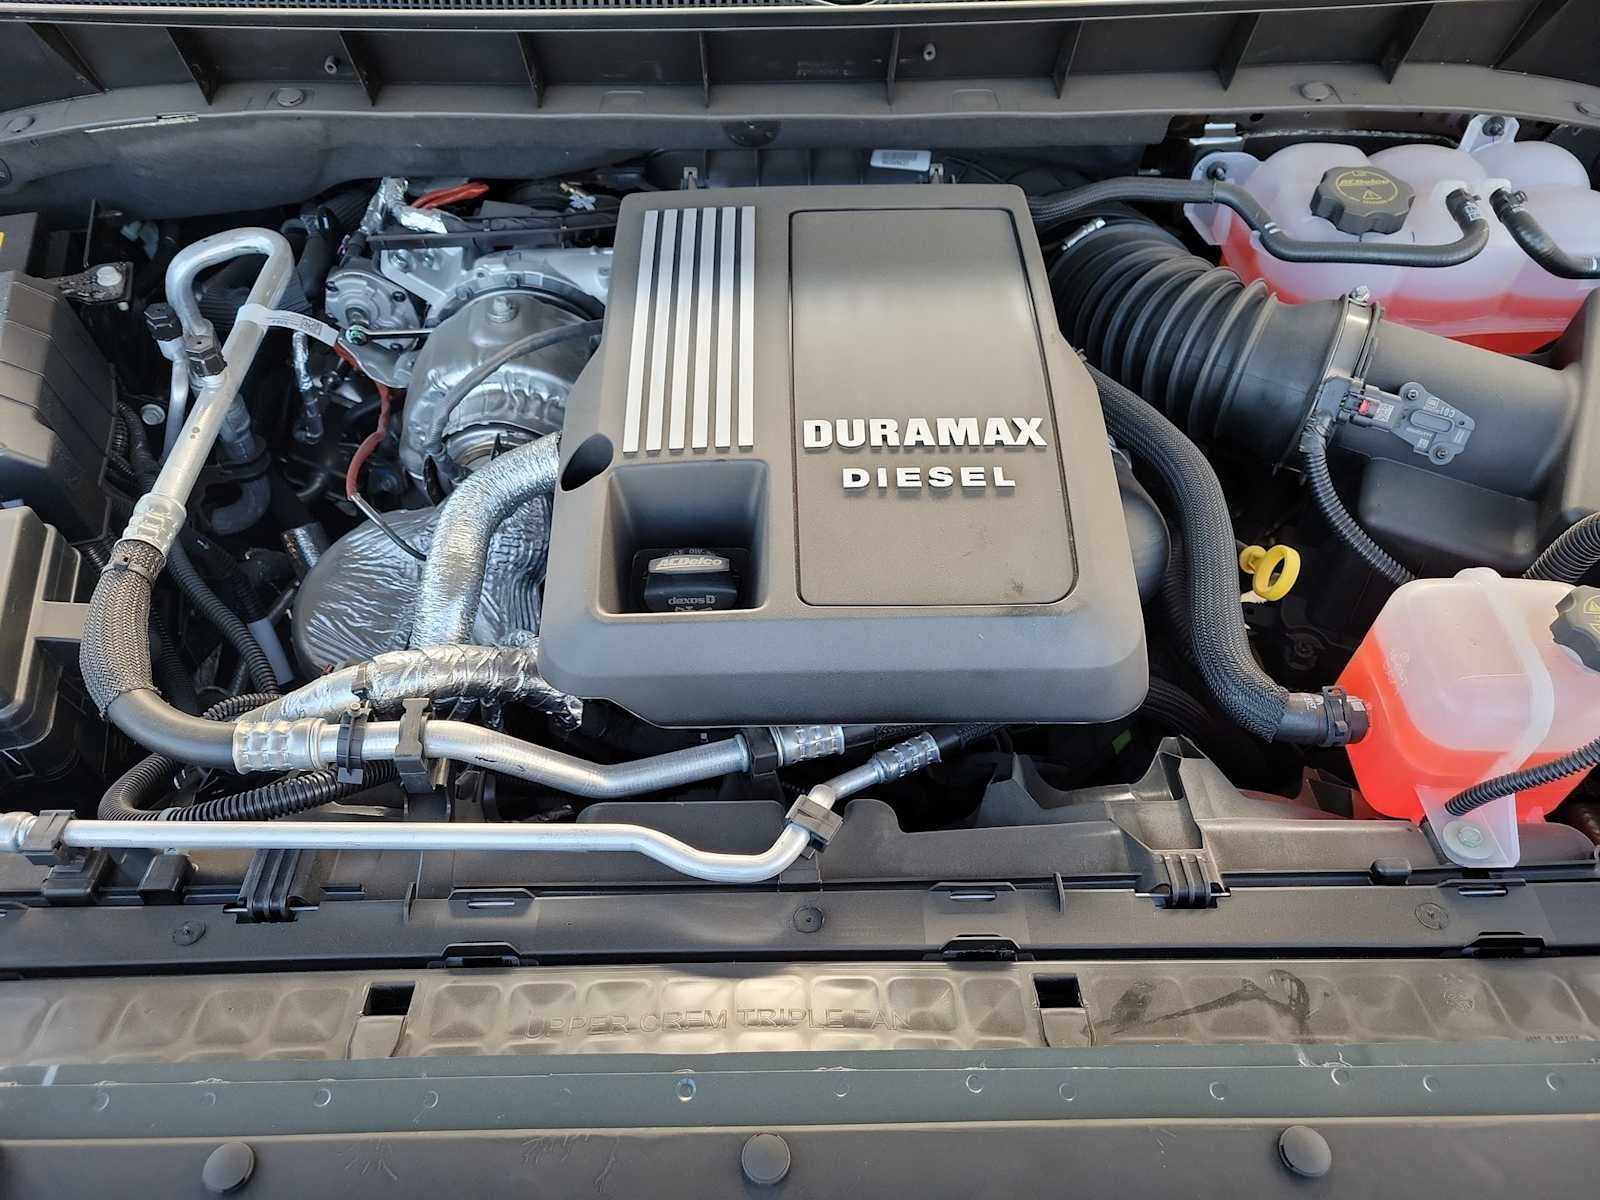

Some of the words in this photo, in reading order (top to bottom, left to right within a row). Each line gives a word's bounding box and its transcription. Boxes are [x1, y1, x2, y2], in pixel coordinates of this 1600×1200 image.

[803, 417, 1048, 448] DURAMAX
[842, 466, 1017, 488] DIESEL
[656, 557, 722, 570] ACDelco
[526, 1012, 630, 1039] UPPER
[736, 1008, 847, 1031] TRIPLE
[853, 1008, 913, 1031] FAN
